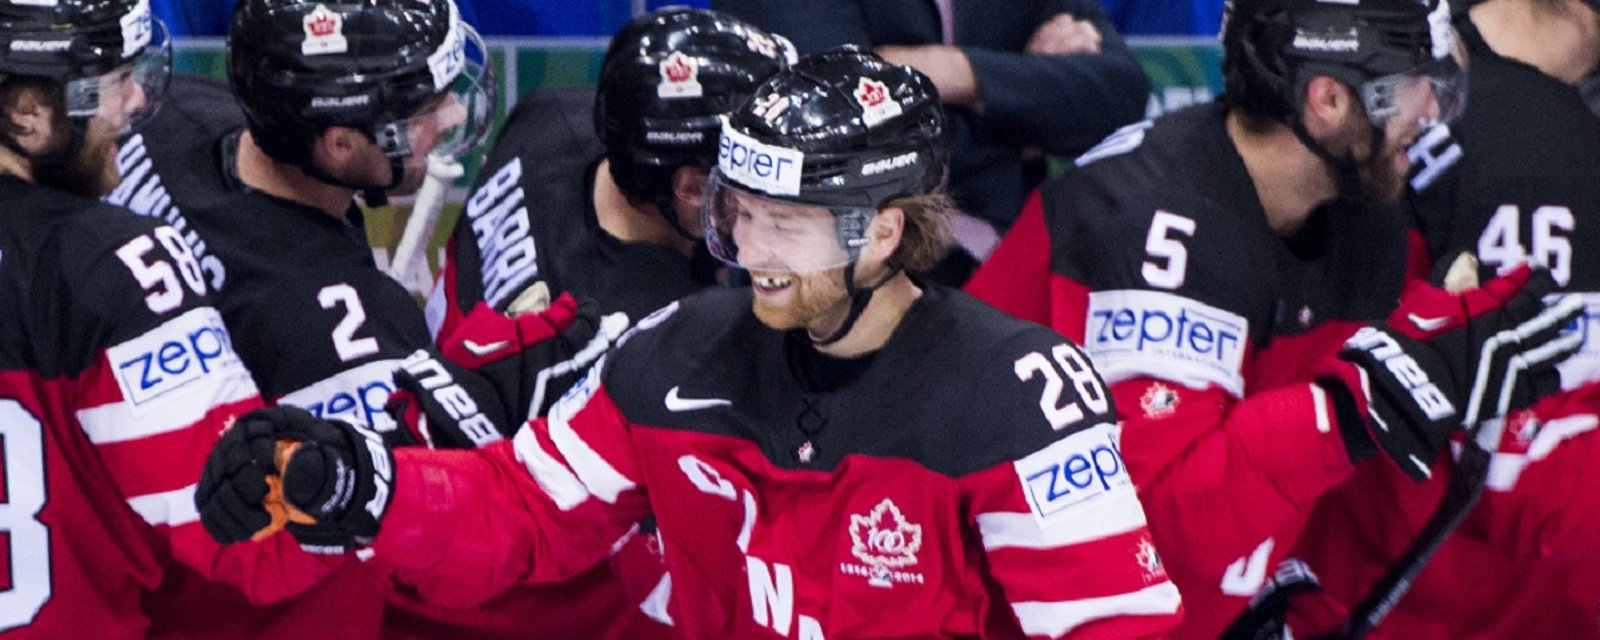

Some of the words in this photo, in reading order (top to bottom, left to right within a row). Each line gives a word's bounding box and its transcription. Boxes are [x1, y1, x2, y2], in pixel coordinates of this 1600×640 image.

[862, 152, 918, 176] BAUER
[114, 225, 208, 315] 58
[1141, 209, 1197, 291] 5
[1477, 204, 1575, 287] 46
[316, 282, 380, 363] 2
[1093, 307, 1238, 362] zepter
[1013, 342, 1110, 431] 28
